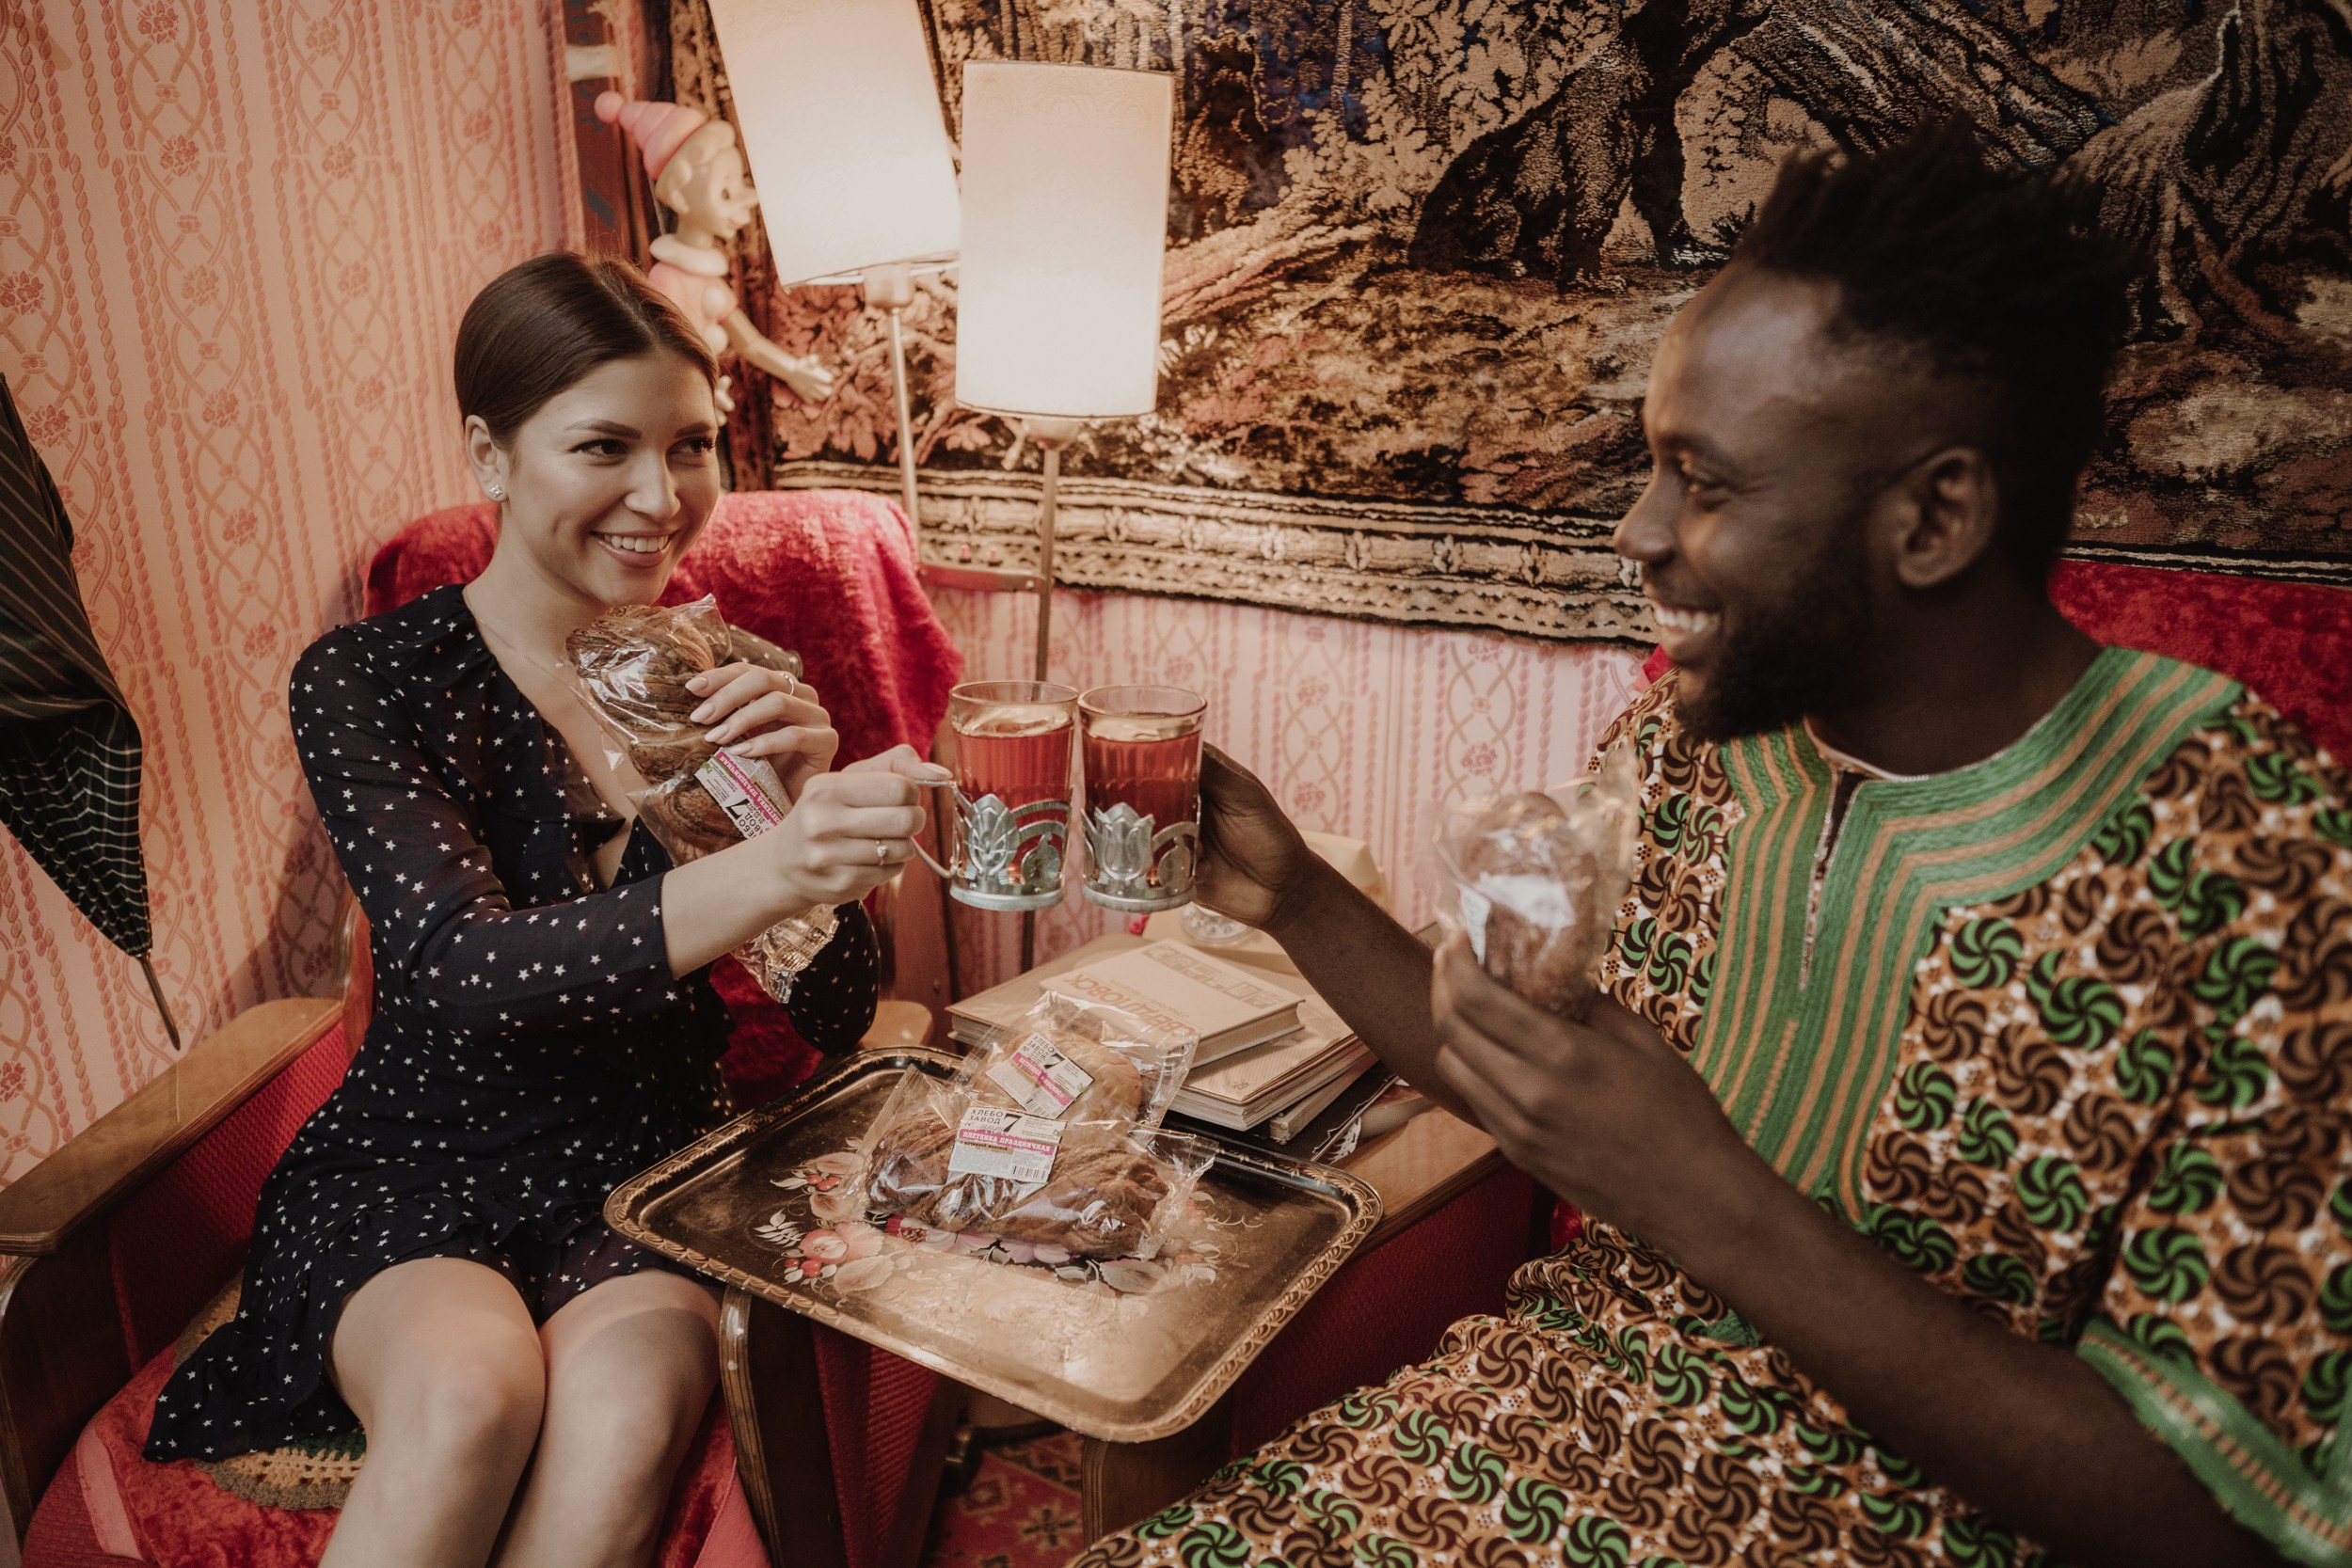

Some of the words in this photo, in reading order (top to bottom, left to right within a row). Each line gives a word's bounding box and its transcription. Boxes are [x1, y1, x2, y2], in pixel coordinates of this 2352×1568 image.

[720, 755, 758, 797] ПРАЗДНИЧНАЯ
[725, 799, 750, 820] 7
[739, 819, 757, 838] ЕБО
[744, 812, 763, 835] АВОД
[1064, 974, 1197, 1036] СВЕРДЛОВСК
[1027, 1040, 1049, 1060] ЗАВОД
[1033, 1036, 1055, 1053] ХЛЕБО
[1043, 1052, 1065, 1069] 7
[968, 1116, 1001, 1125] ЗАВОД
[971, 1109, 1004, 1117] ХЛЕБО
[1003, 1113, 1023, 1132] 7
[961, 1131, 998, 1142] ПЛЕТЕНКА
[999, 1137, 1051, 1152] ПРАЗДНИЧНАЯ
